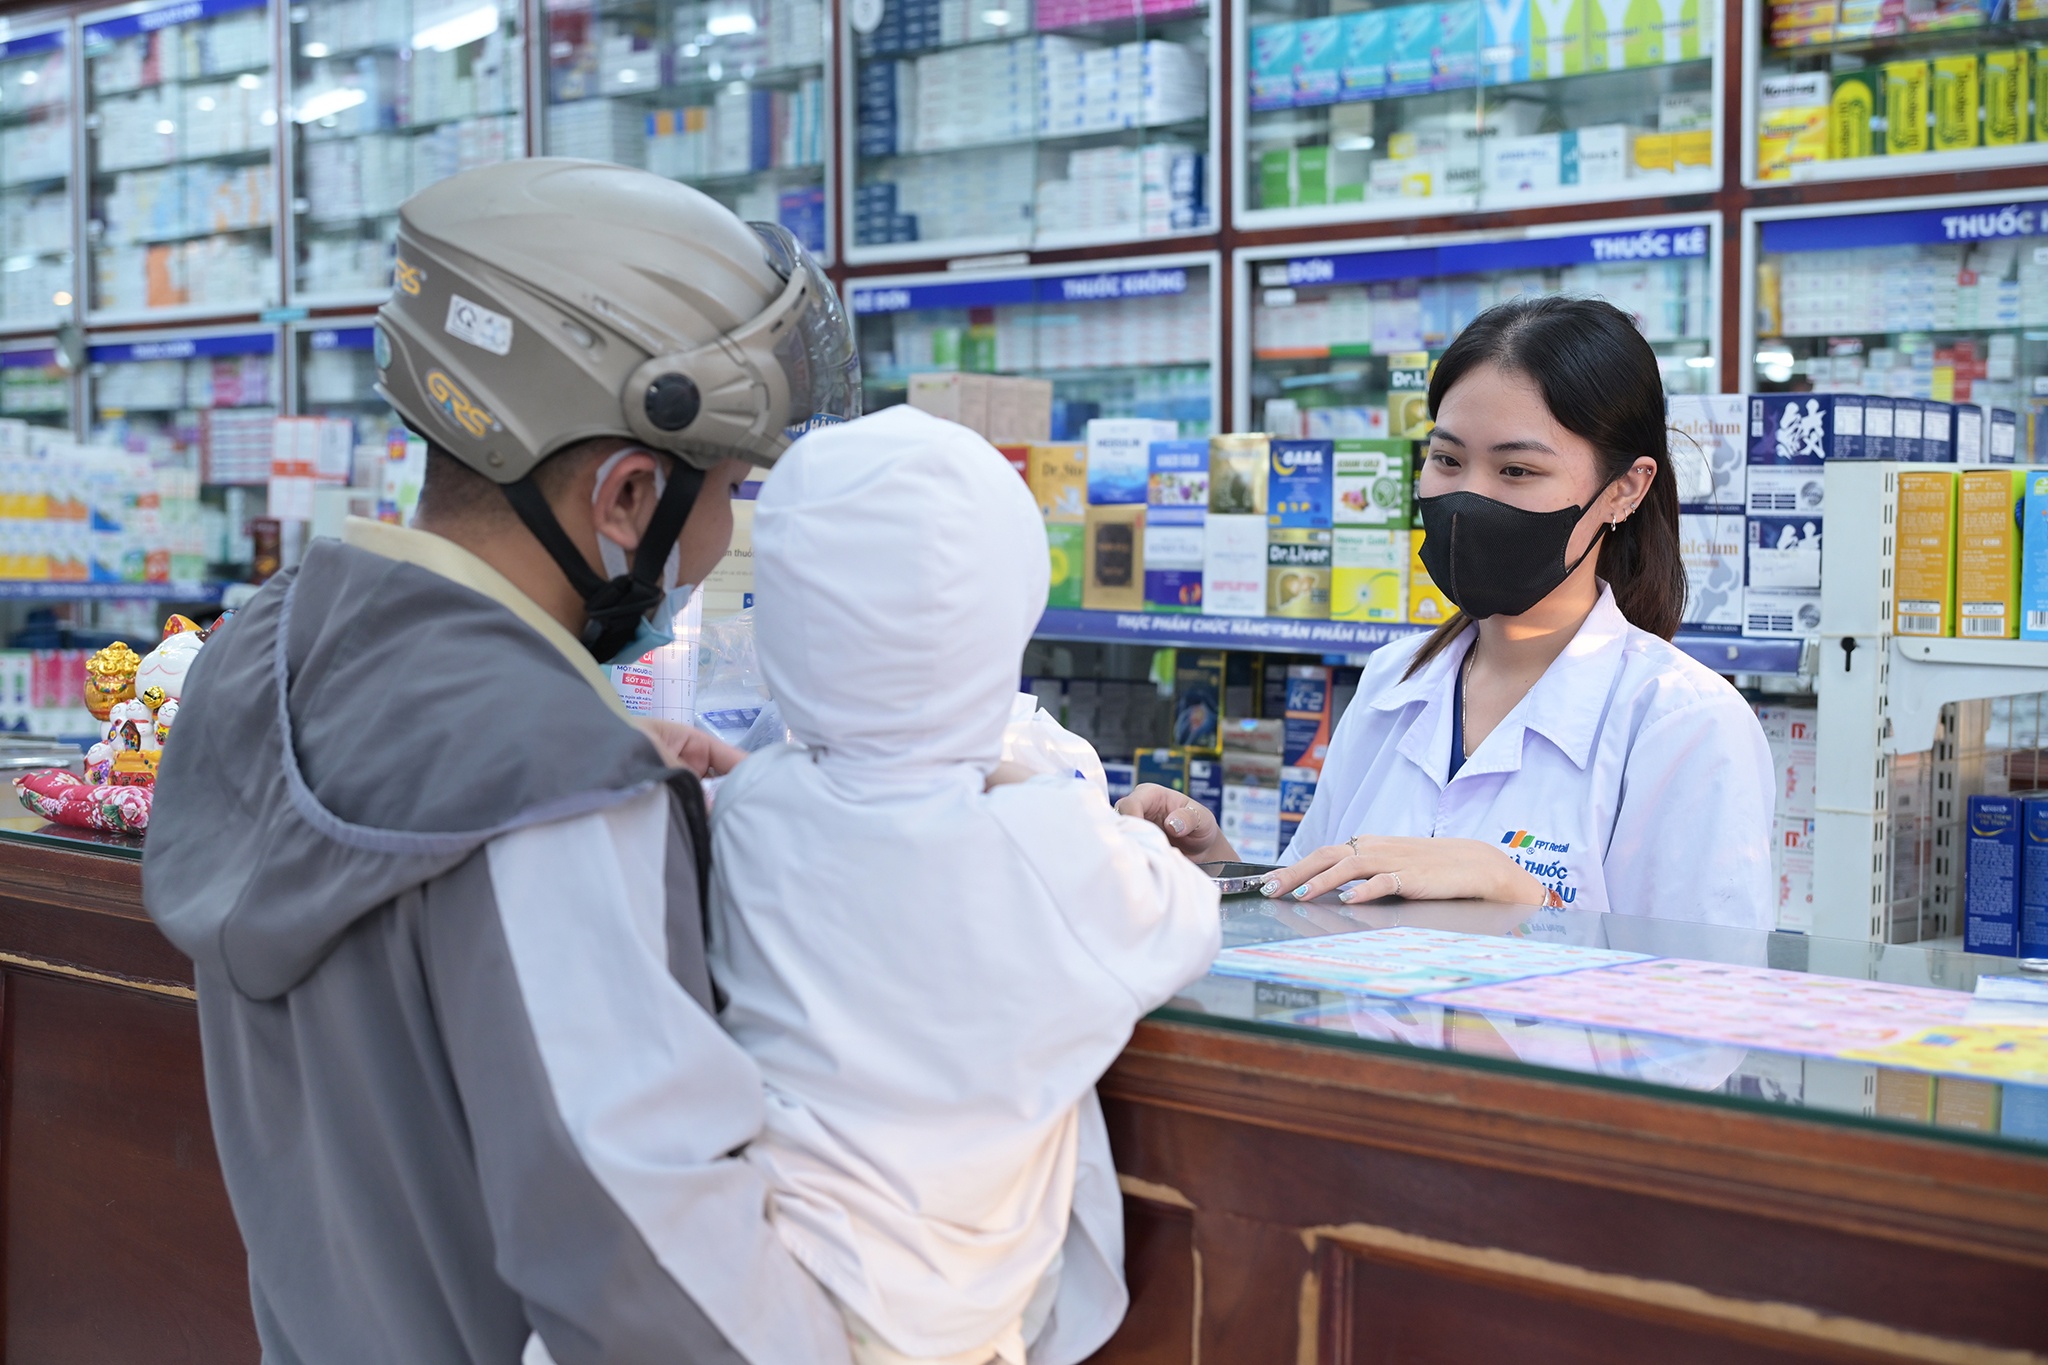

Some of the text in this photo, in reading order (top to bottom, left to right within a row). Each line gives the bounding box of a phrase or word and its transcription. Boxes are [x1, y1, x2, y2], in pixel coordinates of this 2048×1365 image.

[1941, 204, 2035, 239] THUỐC
[1591, 228, 1672, 259] THUỐC
[1061, 269, 1187, 300] THUỐC KHÔNG
[1672, 418, 1741, 435] Calcium
[1269, 544, 1330, 562] Dr.Liver
[1680, 538, 1738, 556] alcium
[1117, 614, 1149, 632] THỰC
[1152, 614, 1190, 632] PHẨM
[1192, 616, 1230, 634] CHỨC
[1231, 618, 1270, 637] NĂNG
[1312, 622, 1355, 643] PHẨM
[1356, 627, 1386, 643] NÀY
[625, 673, 639, 683] SỐT
[1534, 840, 1570, 854] FPT Retail
[1524, 860, 1568, 880] THUỐC
